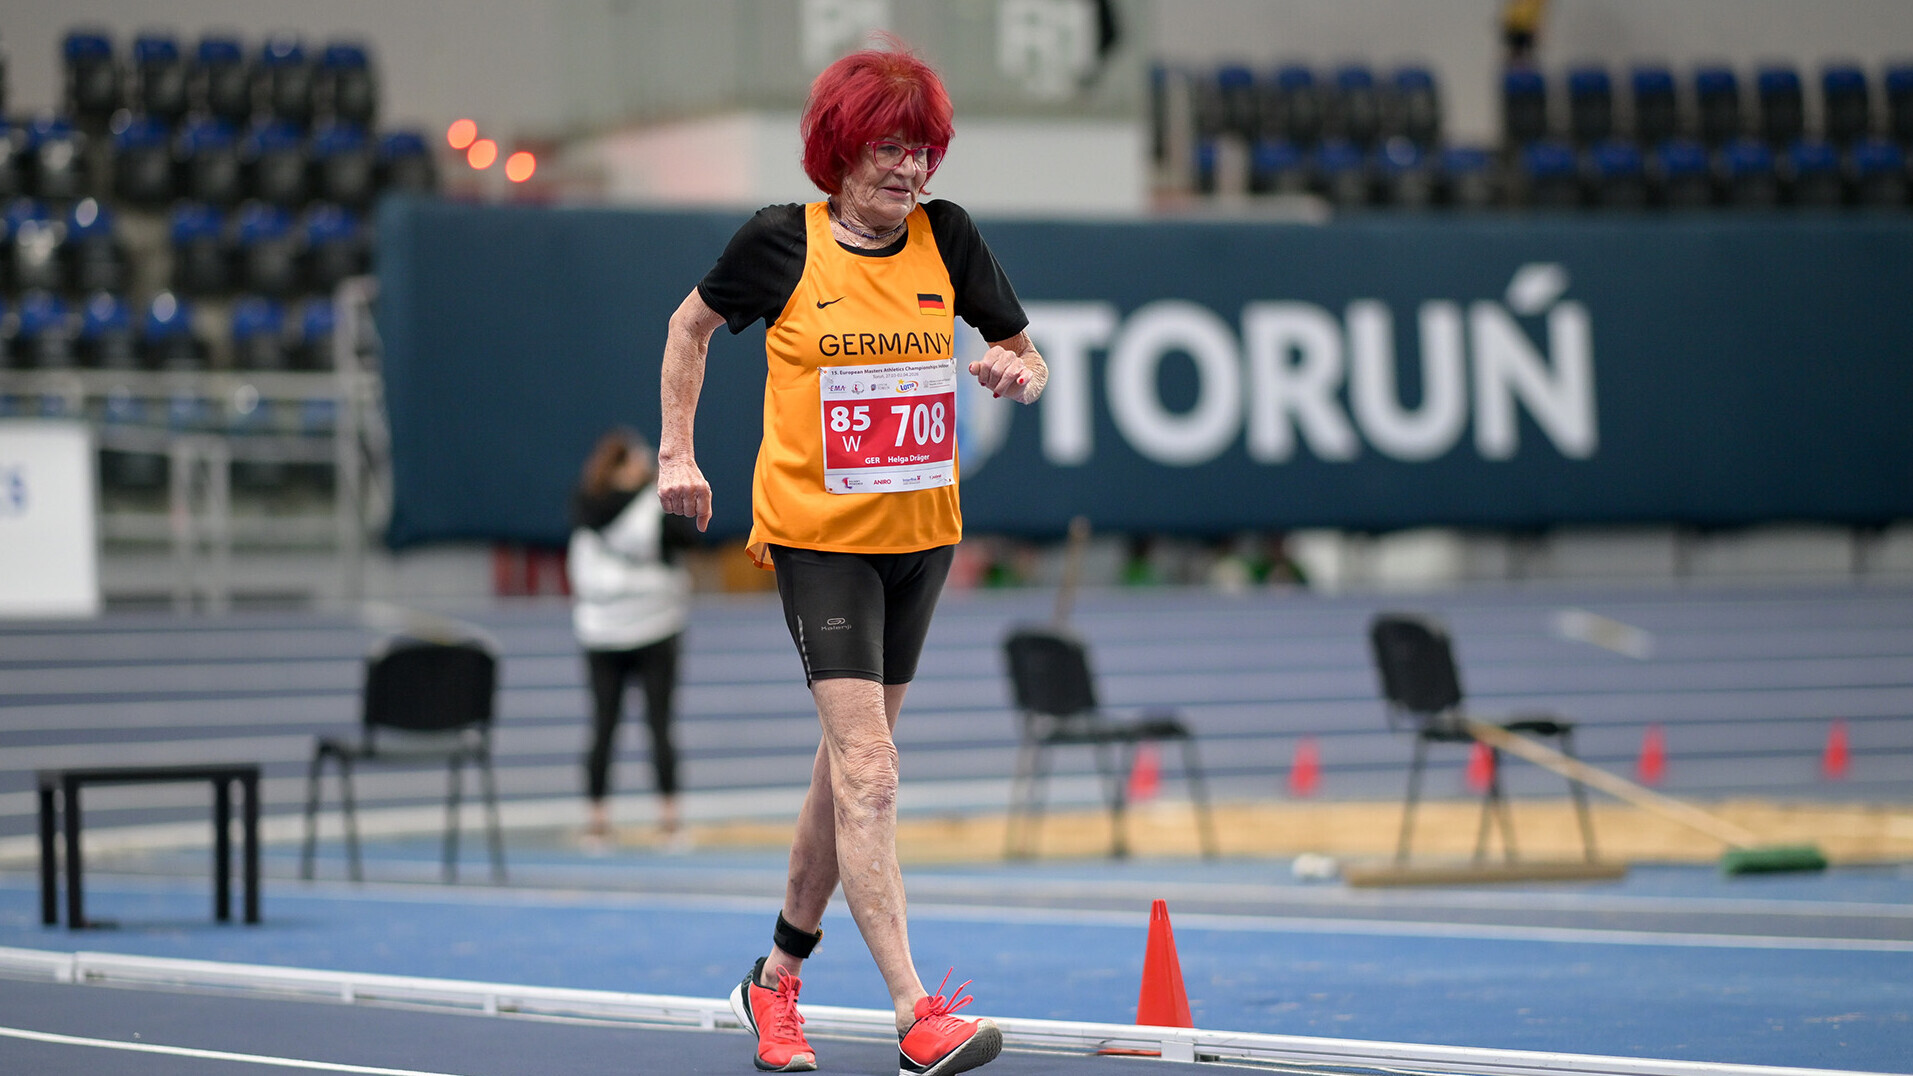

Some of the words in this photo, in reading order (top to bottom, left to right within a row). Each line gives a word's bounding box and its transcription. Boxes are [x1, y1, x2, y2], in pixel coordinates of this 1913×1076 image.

[819, 331, 951, 357] GERMANY
[839, 368, 864, 377] European
[864, 367, 883, 375] Masters
[883, 365, 905, 373] Athletics
[1022, 262, 1598, 466] TORUŃ
[830, 405, 871, 433] 85
[890, 401, 946, 447] 708
[842, 435, 861, 453] W
[864, 456, 881, 465] GER
[887, 455, 909, 465] Helga
[909, 453, 930, 463] Dräger
[873, 478, 892, 486] ANIRO
